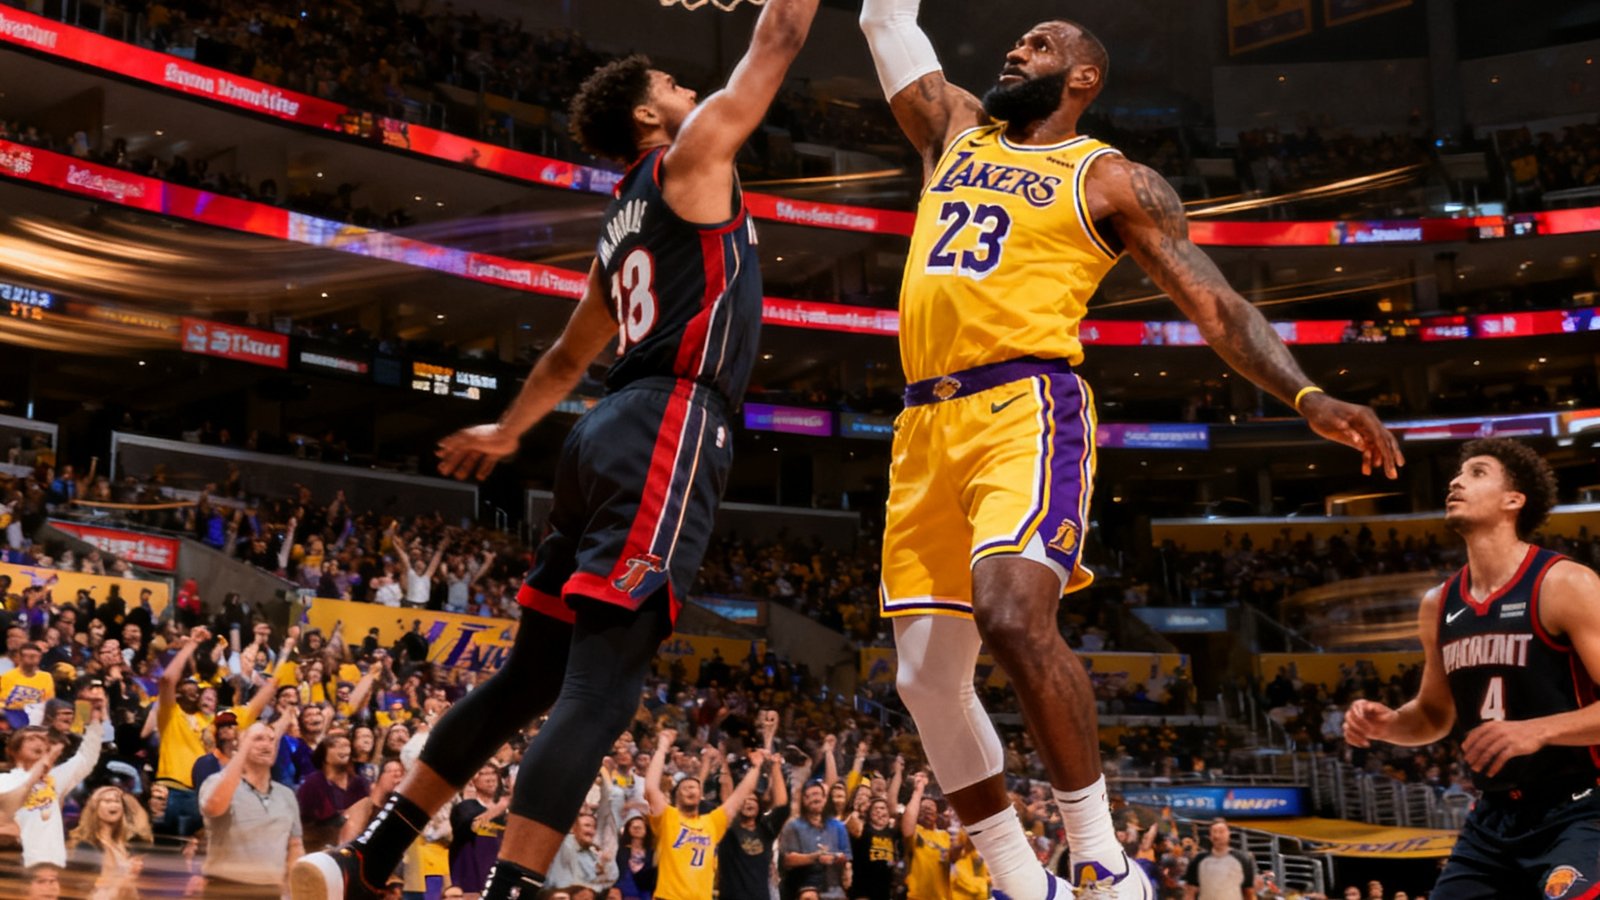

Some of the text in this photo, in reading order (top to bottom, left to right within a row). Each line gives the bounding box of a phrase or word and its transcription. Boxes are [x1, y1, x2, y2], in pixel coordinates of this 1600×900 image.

[931, 151, 1061, 207] LAKERS
[925, 200, 1012, 280] 23
[611, 245, 659, 355] 13
[1480, 675, 1506, 721] 4
